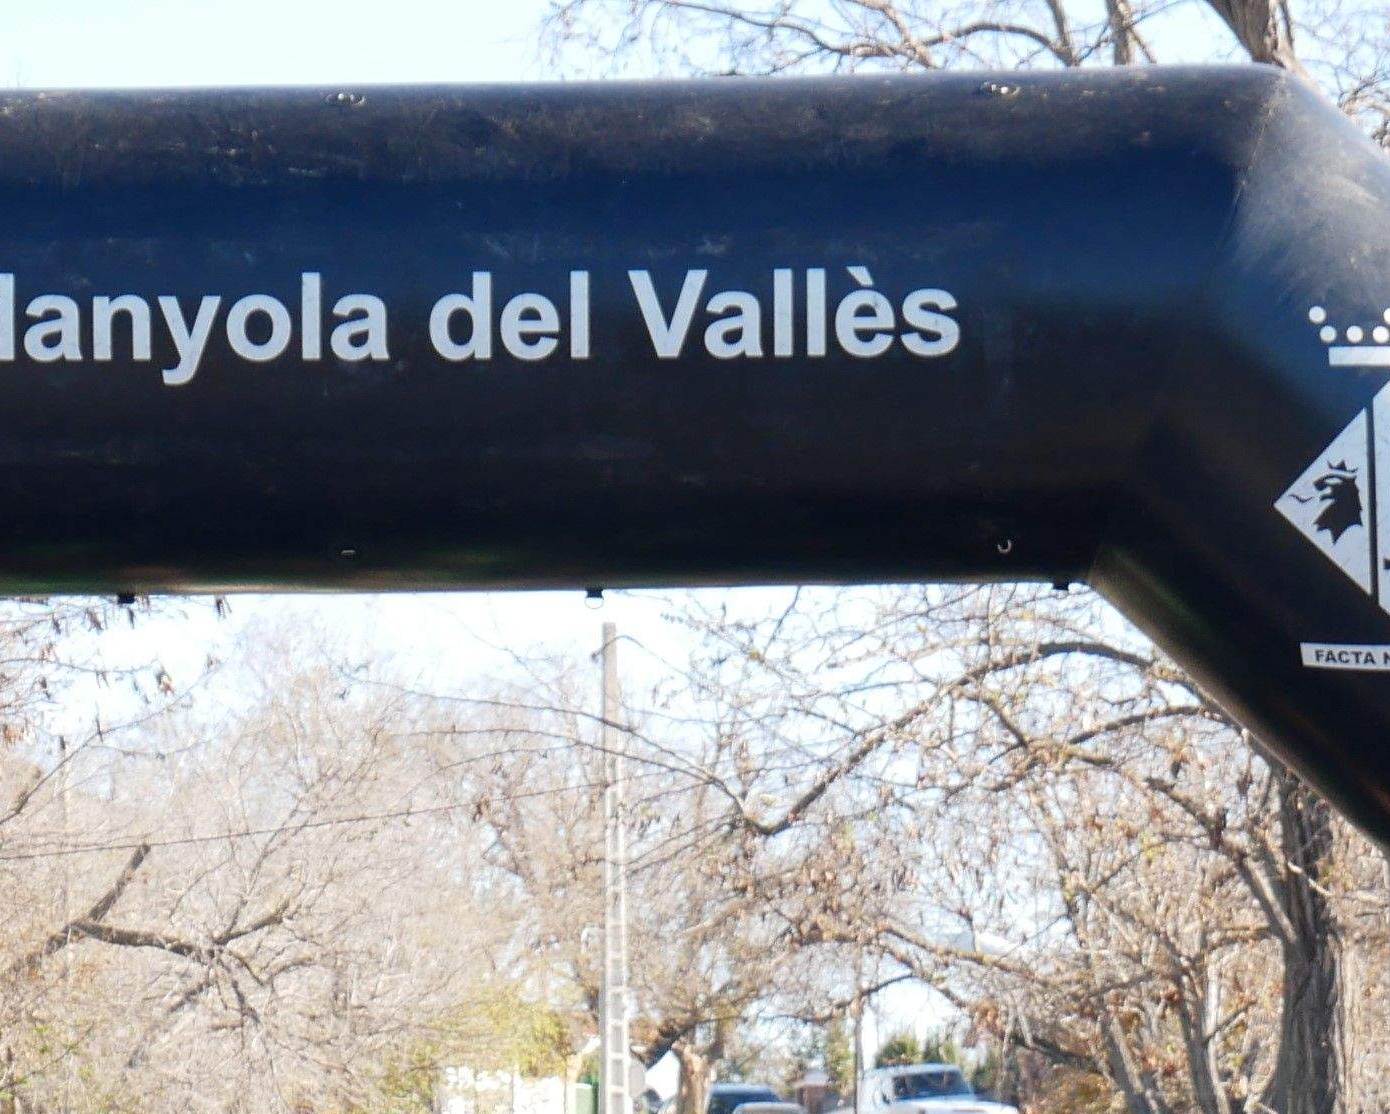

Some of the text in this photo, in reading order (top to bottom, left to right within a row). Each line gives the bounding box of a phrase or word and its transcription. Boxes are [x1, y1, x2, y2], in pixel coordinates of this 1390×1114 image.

[428, 271, 590, 361] del
[629, 268, 961, 360] Vallès
[1314, 649, 1375, 665] FACTA
